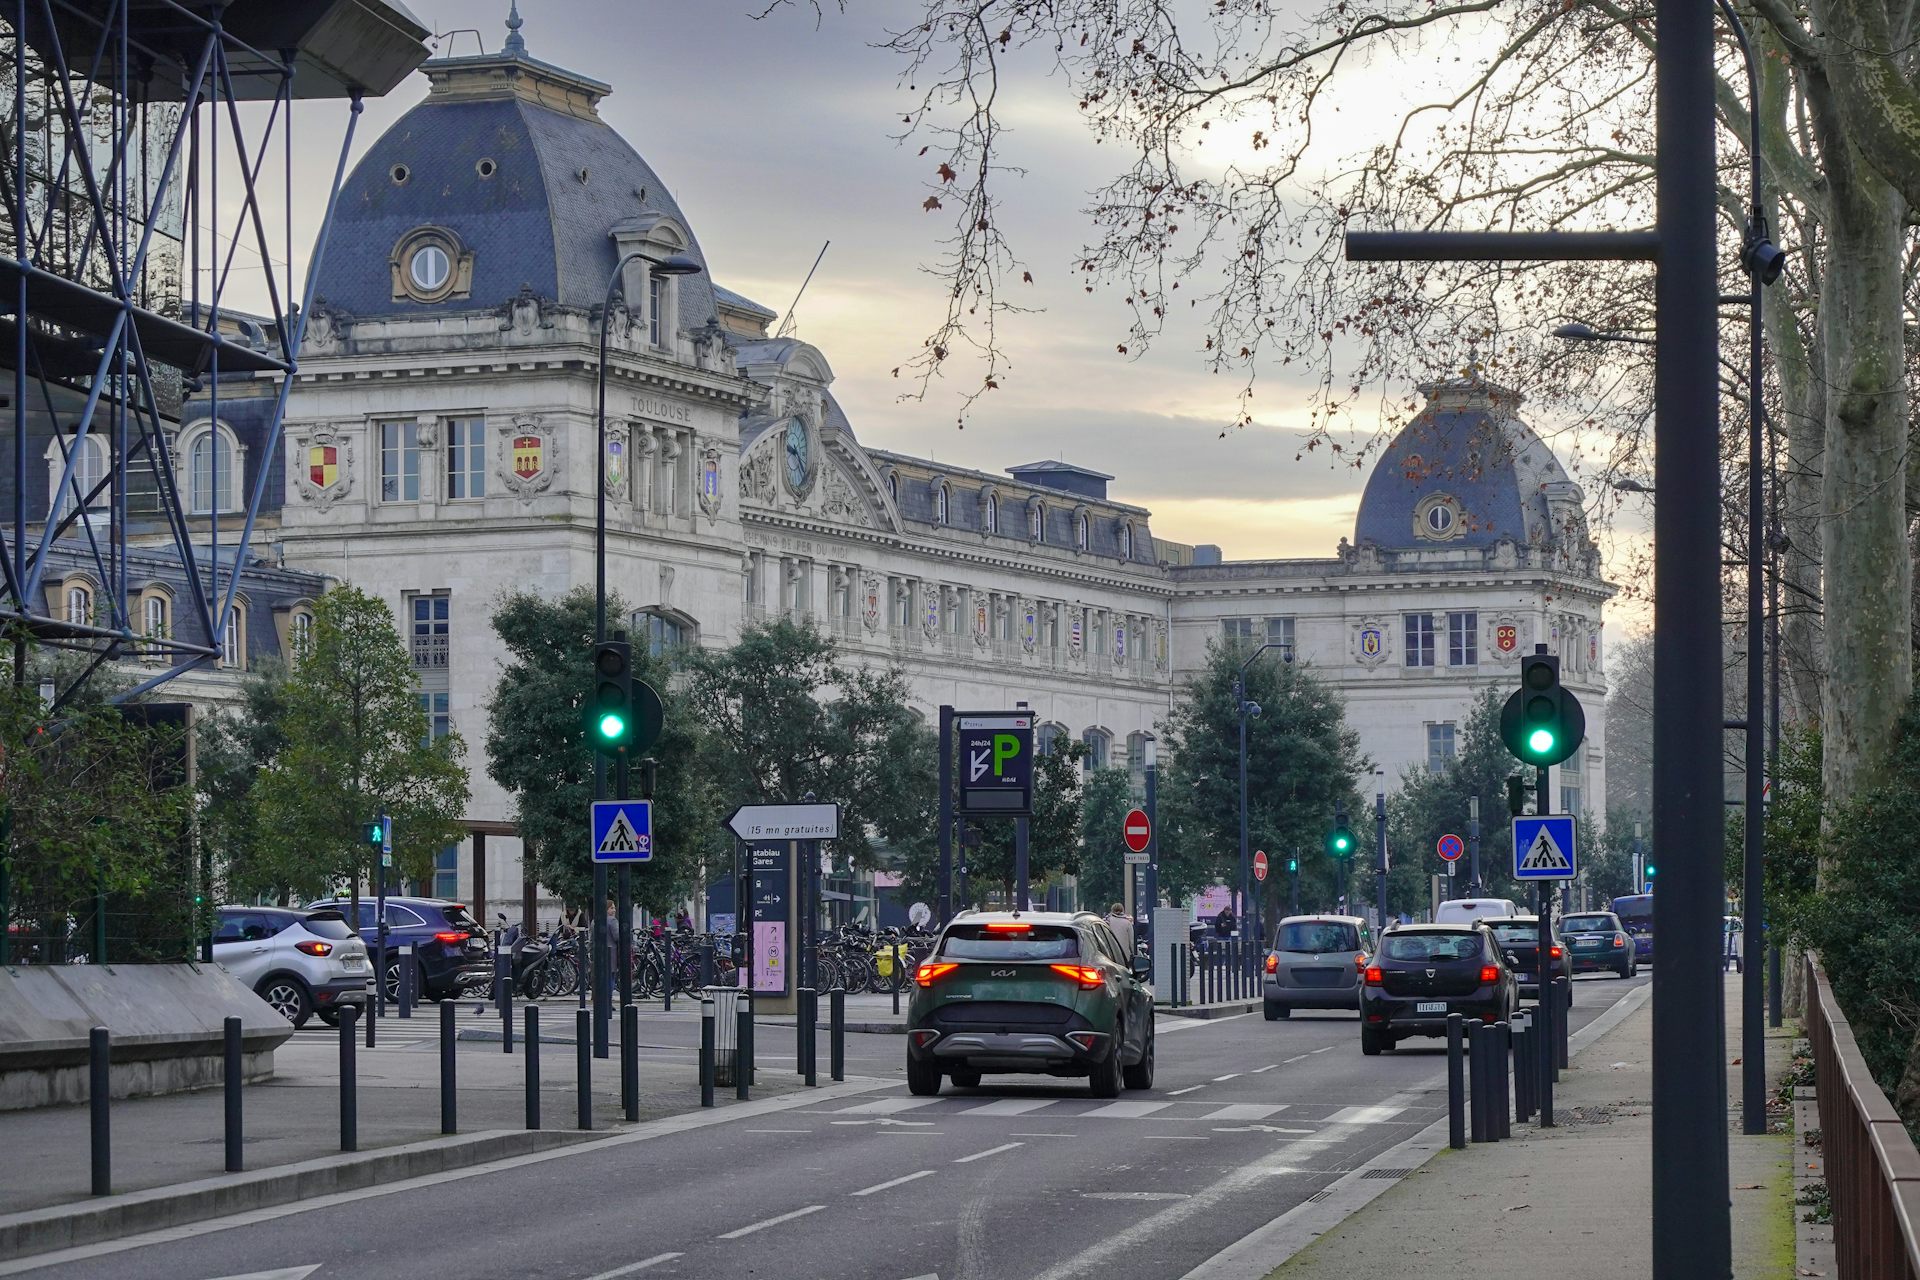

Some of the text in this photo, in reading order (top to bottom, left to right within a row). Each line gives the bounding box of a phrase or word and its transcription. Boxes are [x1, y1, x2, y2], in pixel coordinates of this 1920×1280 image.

[630, 396, 691, 422] TOULOUSE
[743, 530, 778, 548] CHEMINS
[782, 537, 792, 550] DE
[816, 543, 827, 556] DU
[831, 545, 848, 560] MIDI
[994, 734, 1020, 776] P
[765, 826, 780, 835] mn
[753, 857, 773, 865] Gares
